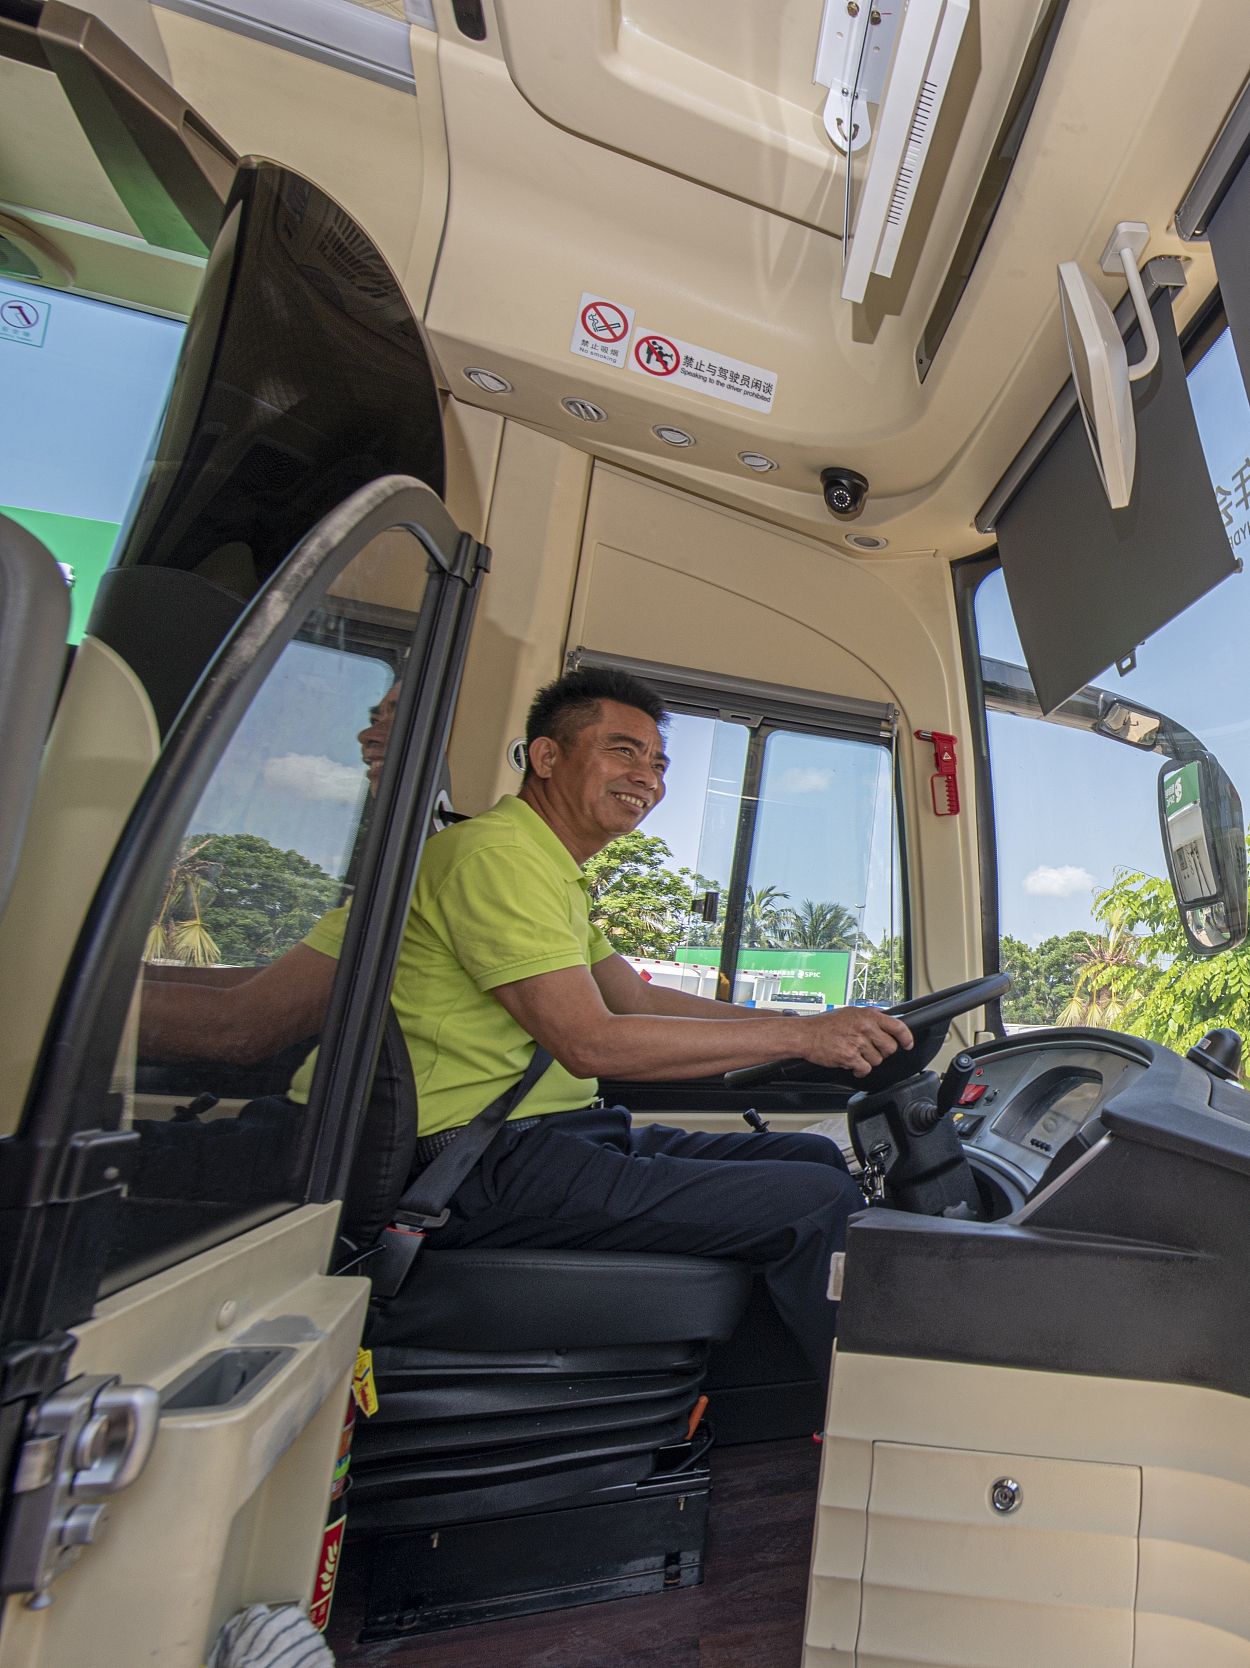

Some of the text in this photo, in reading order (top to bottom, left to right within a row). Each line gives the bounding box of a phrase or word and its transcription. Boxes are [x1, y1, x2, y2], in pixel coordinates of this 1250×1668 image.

[579, 346, 617, 364] No smoking
[580, 339, 620, 357] 禁止吸烟
[680, 367, 708, 383] Speaking
[715, 379, 725, 388] the
[726, 383, 743, 393] driver
[743, 388, 771, 403] prohibited
[682, 354, 774, 396] 禁止与驾驶员闲谈
